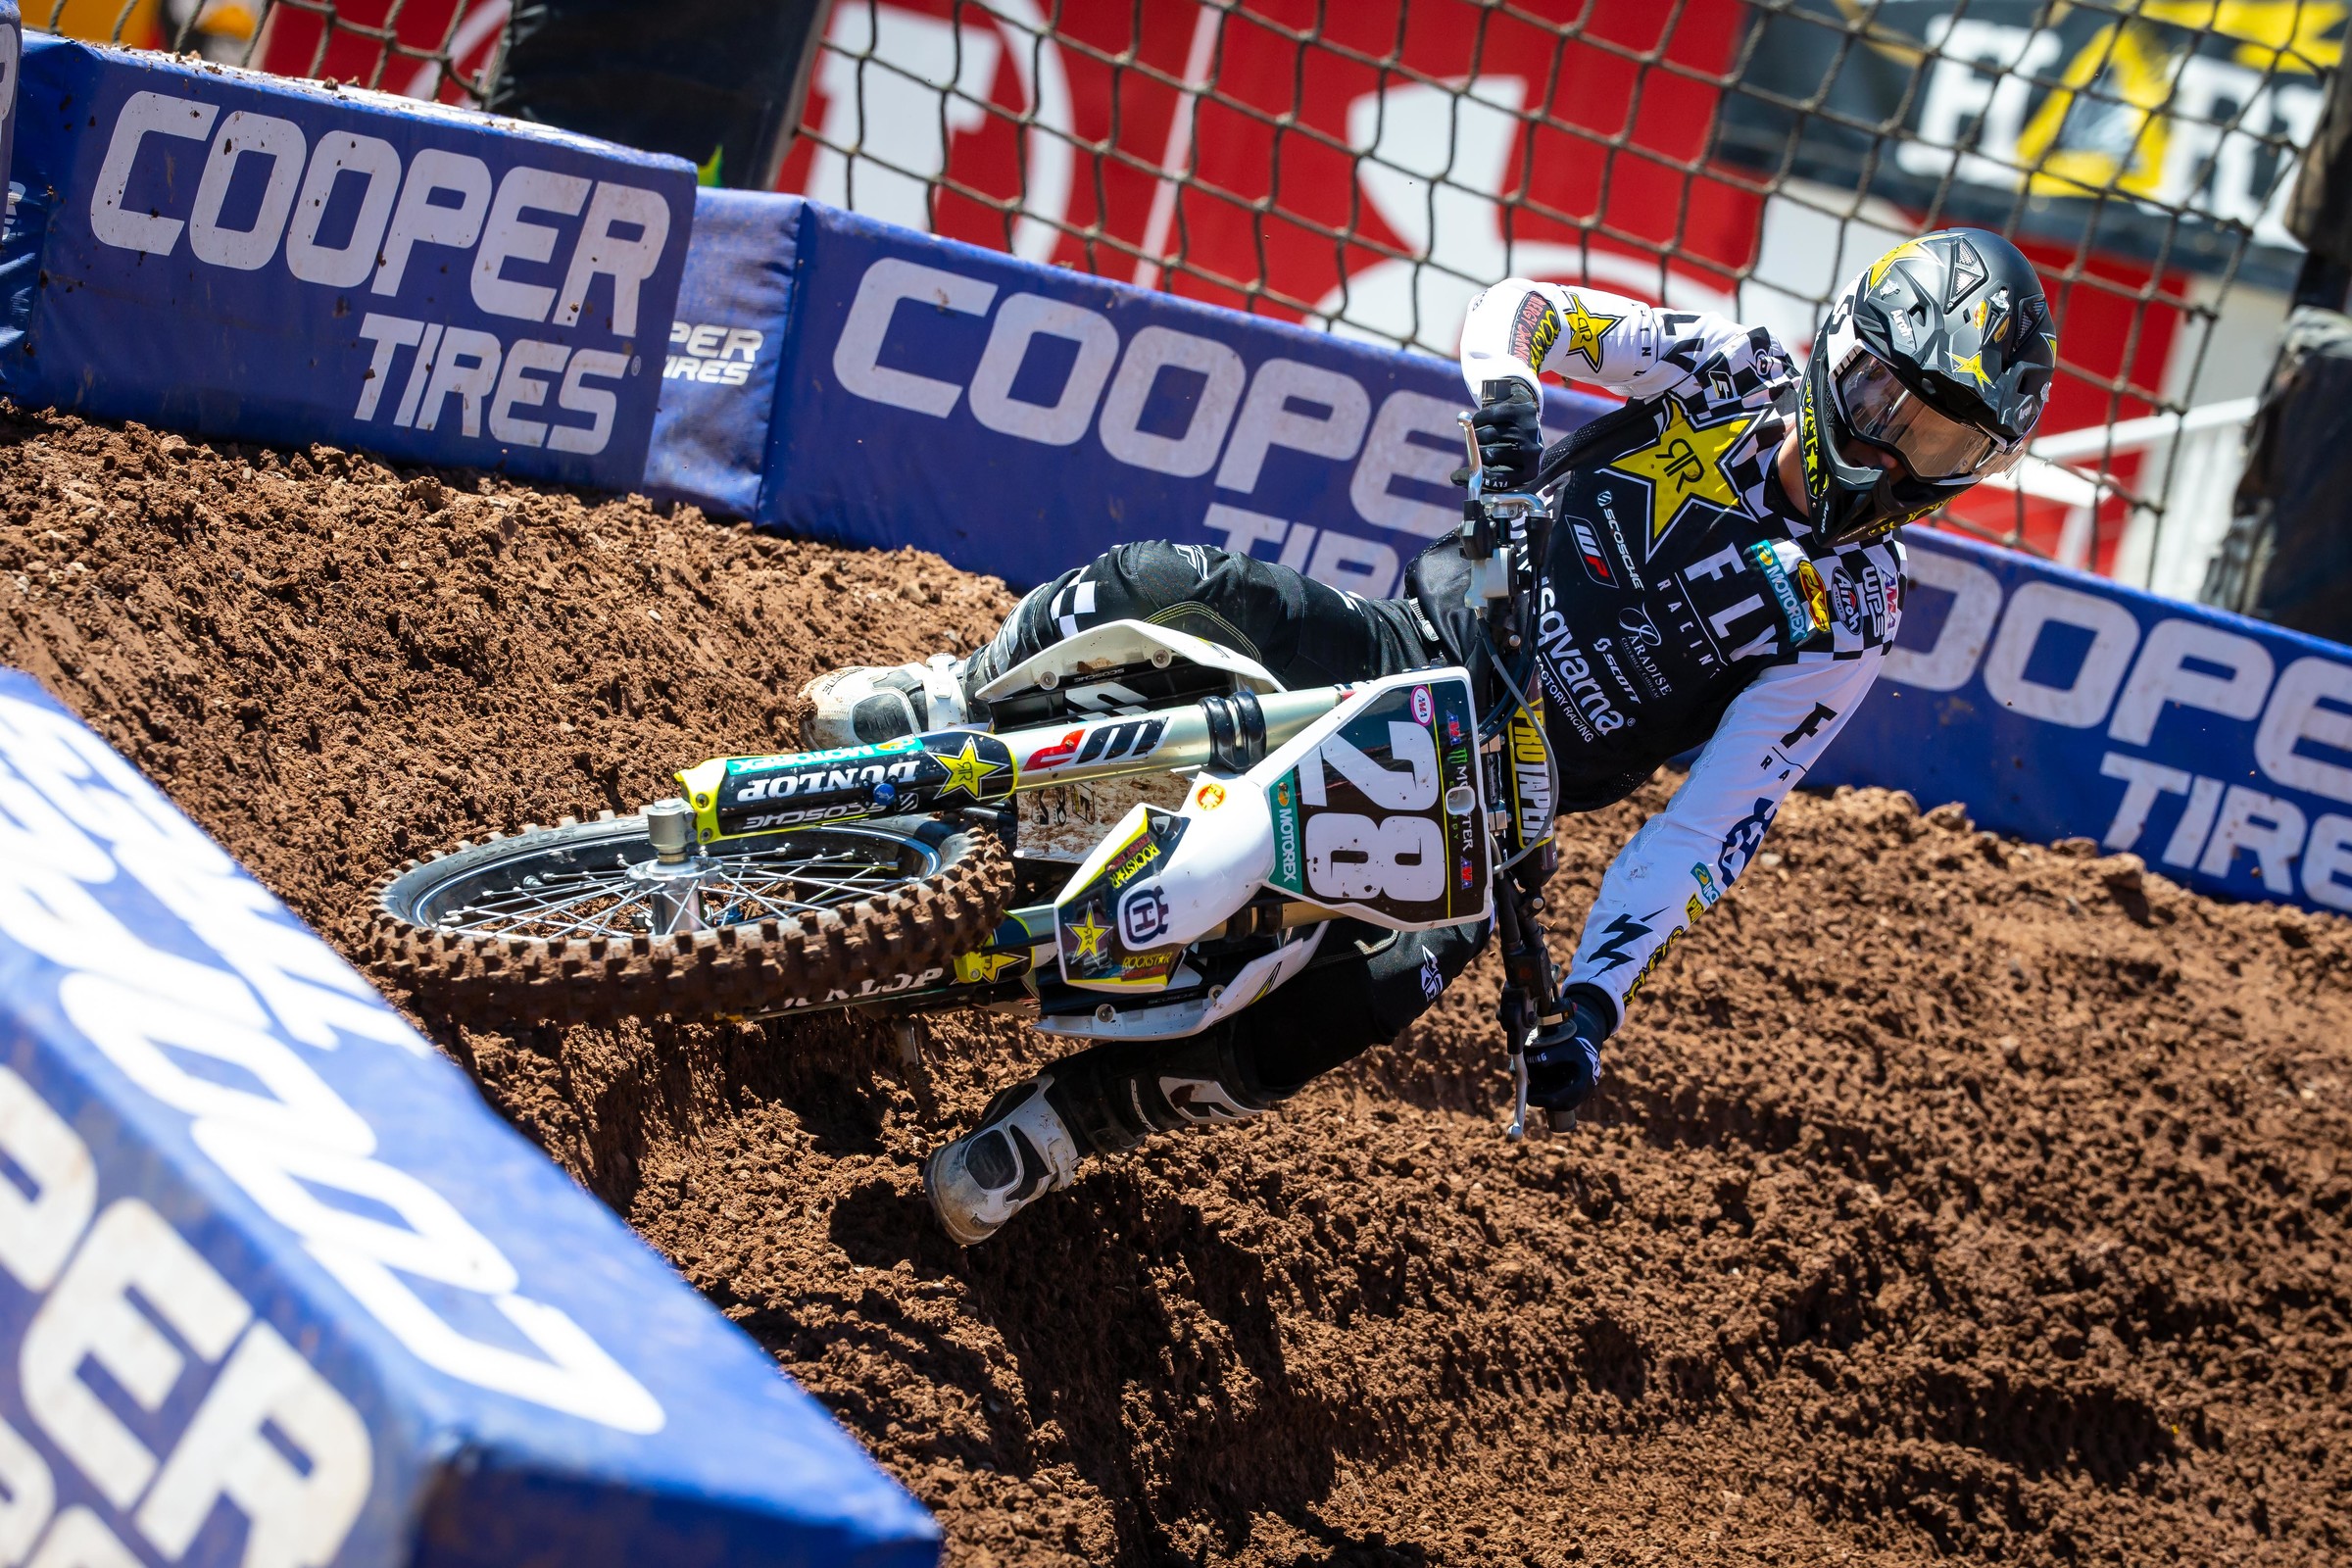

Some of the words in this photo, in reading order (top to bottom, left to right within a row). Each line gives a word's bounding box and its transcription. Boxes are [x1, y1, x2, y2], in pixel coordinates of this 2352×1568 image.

[90, 90, 671, 339] COOPER
[354, 313, 627, 455] TIRES
[662, 354, 755, 386] IRES
[668, 320, 763, 363] PER
[833, 257, 1472, 542] COOPE
[1203, 502, 1401, 600] TIR
[1604, 508, 1645, 591] SCOSCHE
[1656, 577, 1721, 678] RACIN
[1684, 541, 1779, 662] FLY
[1766, 564, 1807, 638] MOTOREX
[1835, 571, 1861, 632] Airoh
[1862, 565, 1886, 638] WPS
[1602, 652, 1642, 705] SCOTT
[1618, 601, 1673, 697] PARADISE
[1876, 546, 2352, 804] OOPE
[1535, 655, 1569, 708] FACTORY
[1562, 707, 1594, 744] RACING
[735, 744, 877, 774] MOTOREX
[737, 760, 922, 804] DUNLOP
[1279, 808, 1298, 884] MOTOREX
[1298, 720, 1446, 902] 28
[2100, 752, 2352, 909] TIRE
[0, 1062, 373, 1568] PER
